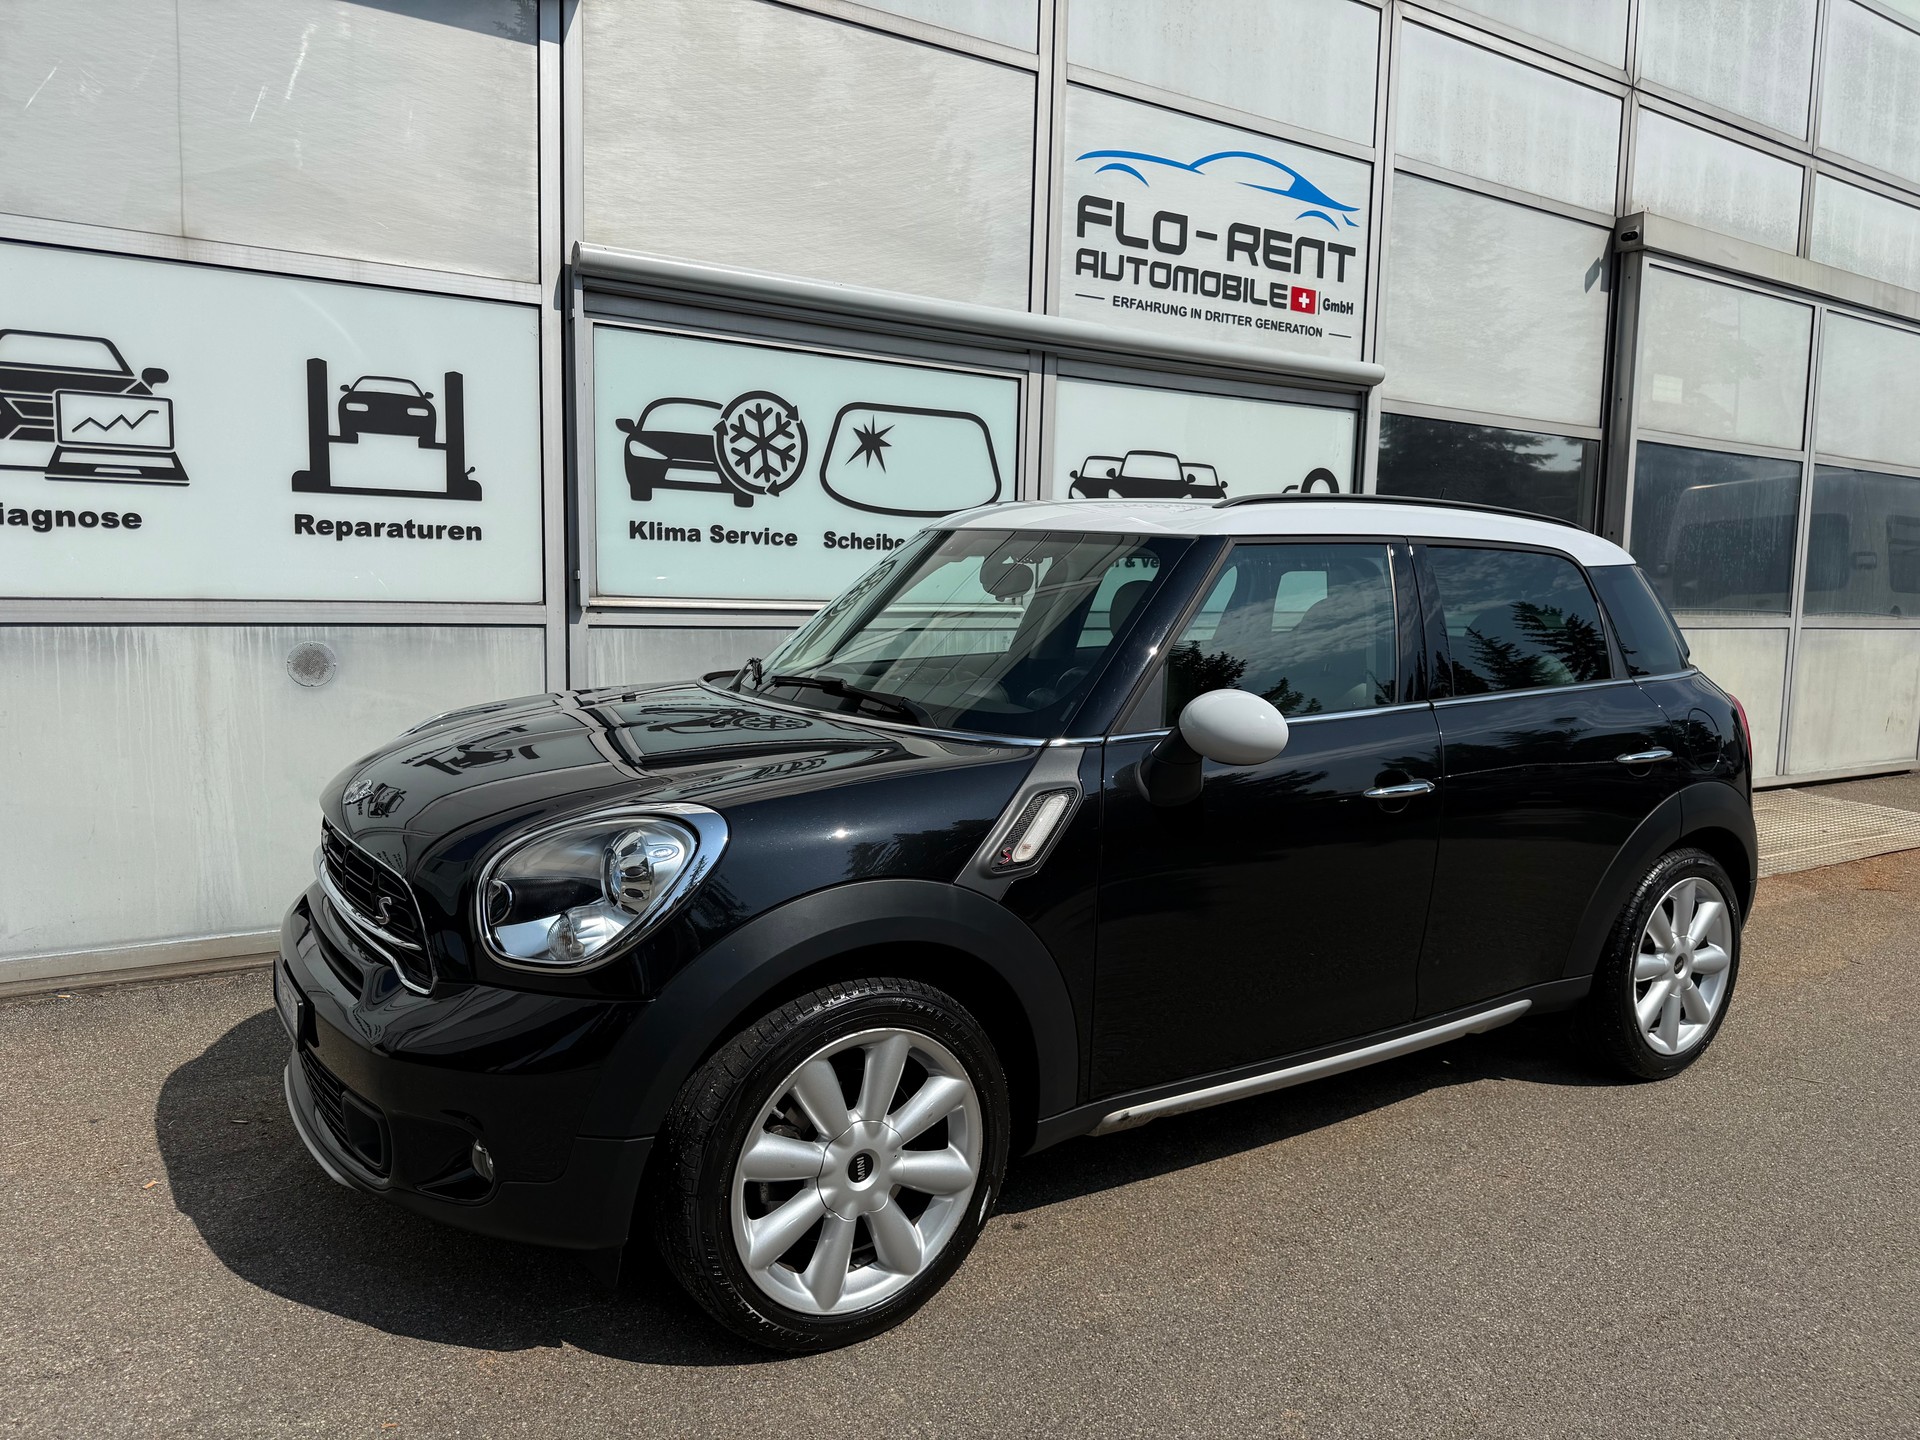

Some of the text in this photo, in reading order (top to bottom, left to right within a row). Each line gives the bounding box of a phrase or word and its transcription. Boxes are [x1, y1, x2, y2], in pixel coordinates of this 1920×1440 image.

[1077, 194, 1356, 283] FLO-RENT
[1075, 248, 1354, 315] AUTOMOBILE GmbH
[1112, 295, 1323, 338] ERFAHRUNG IN DRITTER GENERATION
[294, 513, 483, 541] Reparaturen
[629, 520, 798, 546] Klima Service
[856, 1156, 866, 1181] MINI
